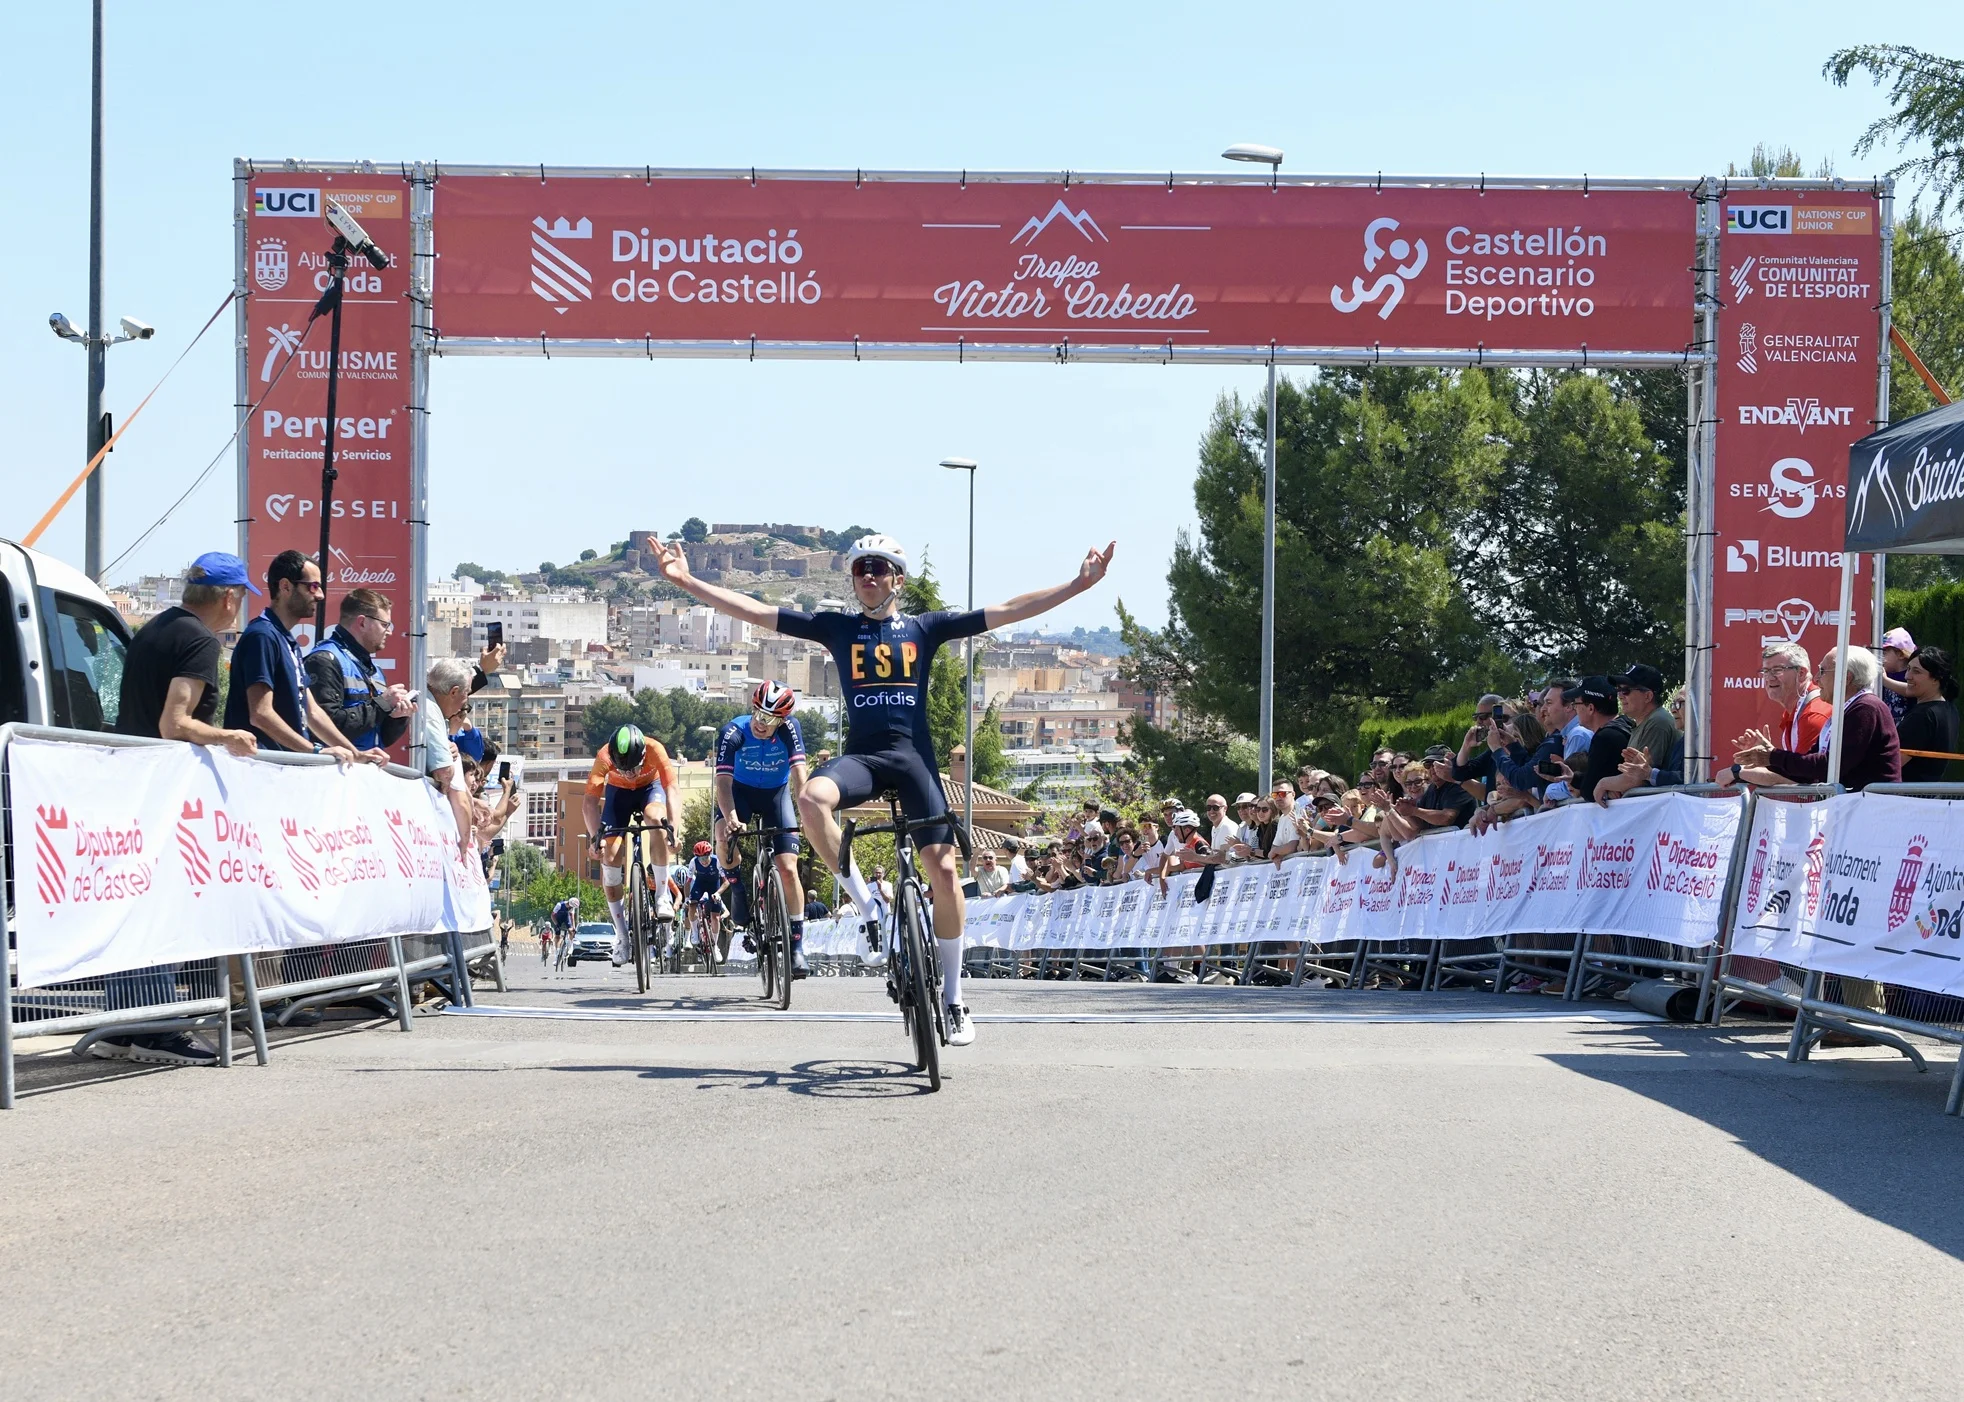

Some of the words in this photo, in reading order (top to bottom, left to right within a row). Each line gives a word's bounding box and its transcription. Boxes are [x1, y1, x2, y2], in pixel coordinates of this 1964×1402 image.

[266, 193, 315, 212] UCI
[376, 194, 397, 204] CUP
[1738, 210, 1787, 229] UCI
[1847, 211, 1866, 220] CUP
[1796, 221, 1834, 230] JUNIOR
[612, 227, 803, 270] Diputació
[1445, 225, 1606, 256] Castellón
[1759, 255, 1807, 265] Comunitat
[1808, 255, 1859, 265] Valenciana
[1013, 253, 1100, 288] Trofeo
[1445, 259, 1595, 286] Escenario
[1758, 267, 1858, 282] COMUNITAT
[611, 269, 659, 303] de
[667, 270, 821, 304] Castelló
[1765, 283, 1788, 298] DE
[1792, 284, 1870, 298] L'ESPORT
[933, 280, 1052, 318] Victor
[1064, 280, 1197, 319] Cabedo
[1445, 289, 1595, 321] Deportivo
[1763, 335, 1860, 347] GENERALITAT
[1764, 350, 1857, 363] VALENCIANA
[346, 371, 398, 380] VALENCIANA
[1738, 398, 1855, 436] ENDAVANT
[263, 449, 326, 460] Peritacione
[332, 451, 339, 463] y
[342, 449, 392, 461] Servicios
[299, 499, 398, 519] PISSEI
[340, 566, 397, 584] Cabedo
[851, 641, 919, 680] ESP
[1723, 677, 1765, 689] MAQUI
[853, 691, 916, 708] Cofidis
[717, 725, 738, 762] CASTELLI
[784, 719, 802, 752] ASTELLI
[739, 758, 786, 767] ITALIA
[219, 850, 244, 884] de
[72, 866, 92, 903] de
